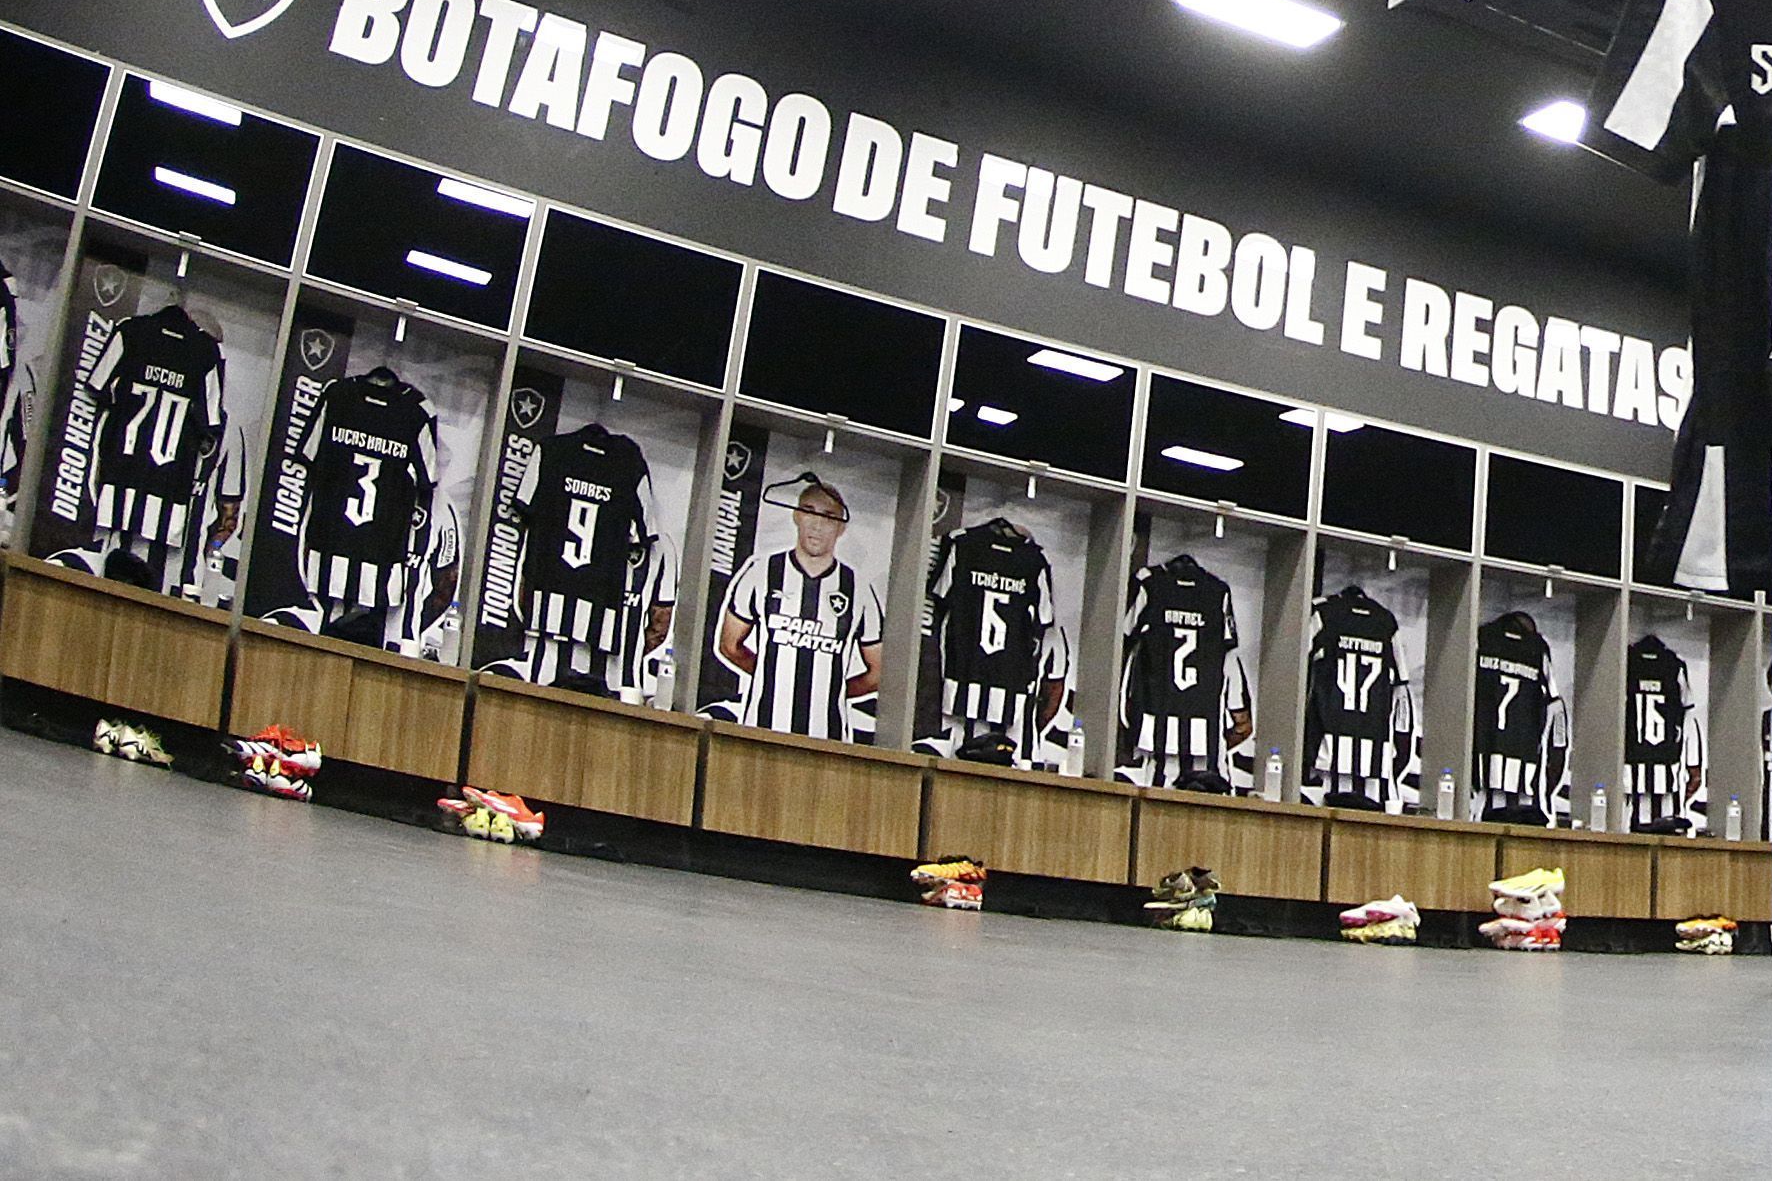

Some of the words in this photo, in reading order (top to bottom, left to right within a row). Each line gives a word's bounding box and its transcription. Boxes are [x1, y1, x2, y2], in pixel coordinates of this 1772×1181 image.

[832, 111, 959, 243] DE
[968, 152, 1325, 346] FUTEBOL
[1340, 260, 1387, 360] E
[1399, 277, 1695, 432] REGATAS
[144, 364, 185, 388] OSCAR
[123, 383, 191, 467] 70
[331, 426, 366, 448] LUCAS
[367, 433, 409, 459] HALTER
[52, 447, 86, 522] DIEGO
[271, 461, 308, 537] LUCAS
[344, 452, 382, 527] 3
[564, 476, 613, 504] SOARES
[561, 498, 600, 569] 9
[481, 522, 521, 629] TIQUINHO
[768, 613, 822, 636] PARI
[773, 629, 844, 655] MATCH
[979, 590, 1010, 655] 6
[1173, 628, 1198, 692] 2
[1336, 653, 1383, 713] 47
[1498, 675, 1521, 730] 7
[1635, 693, 1665, 746] 16
